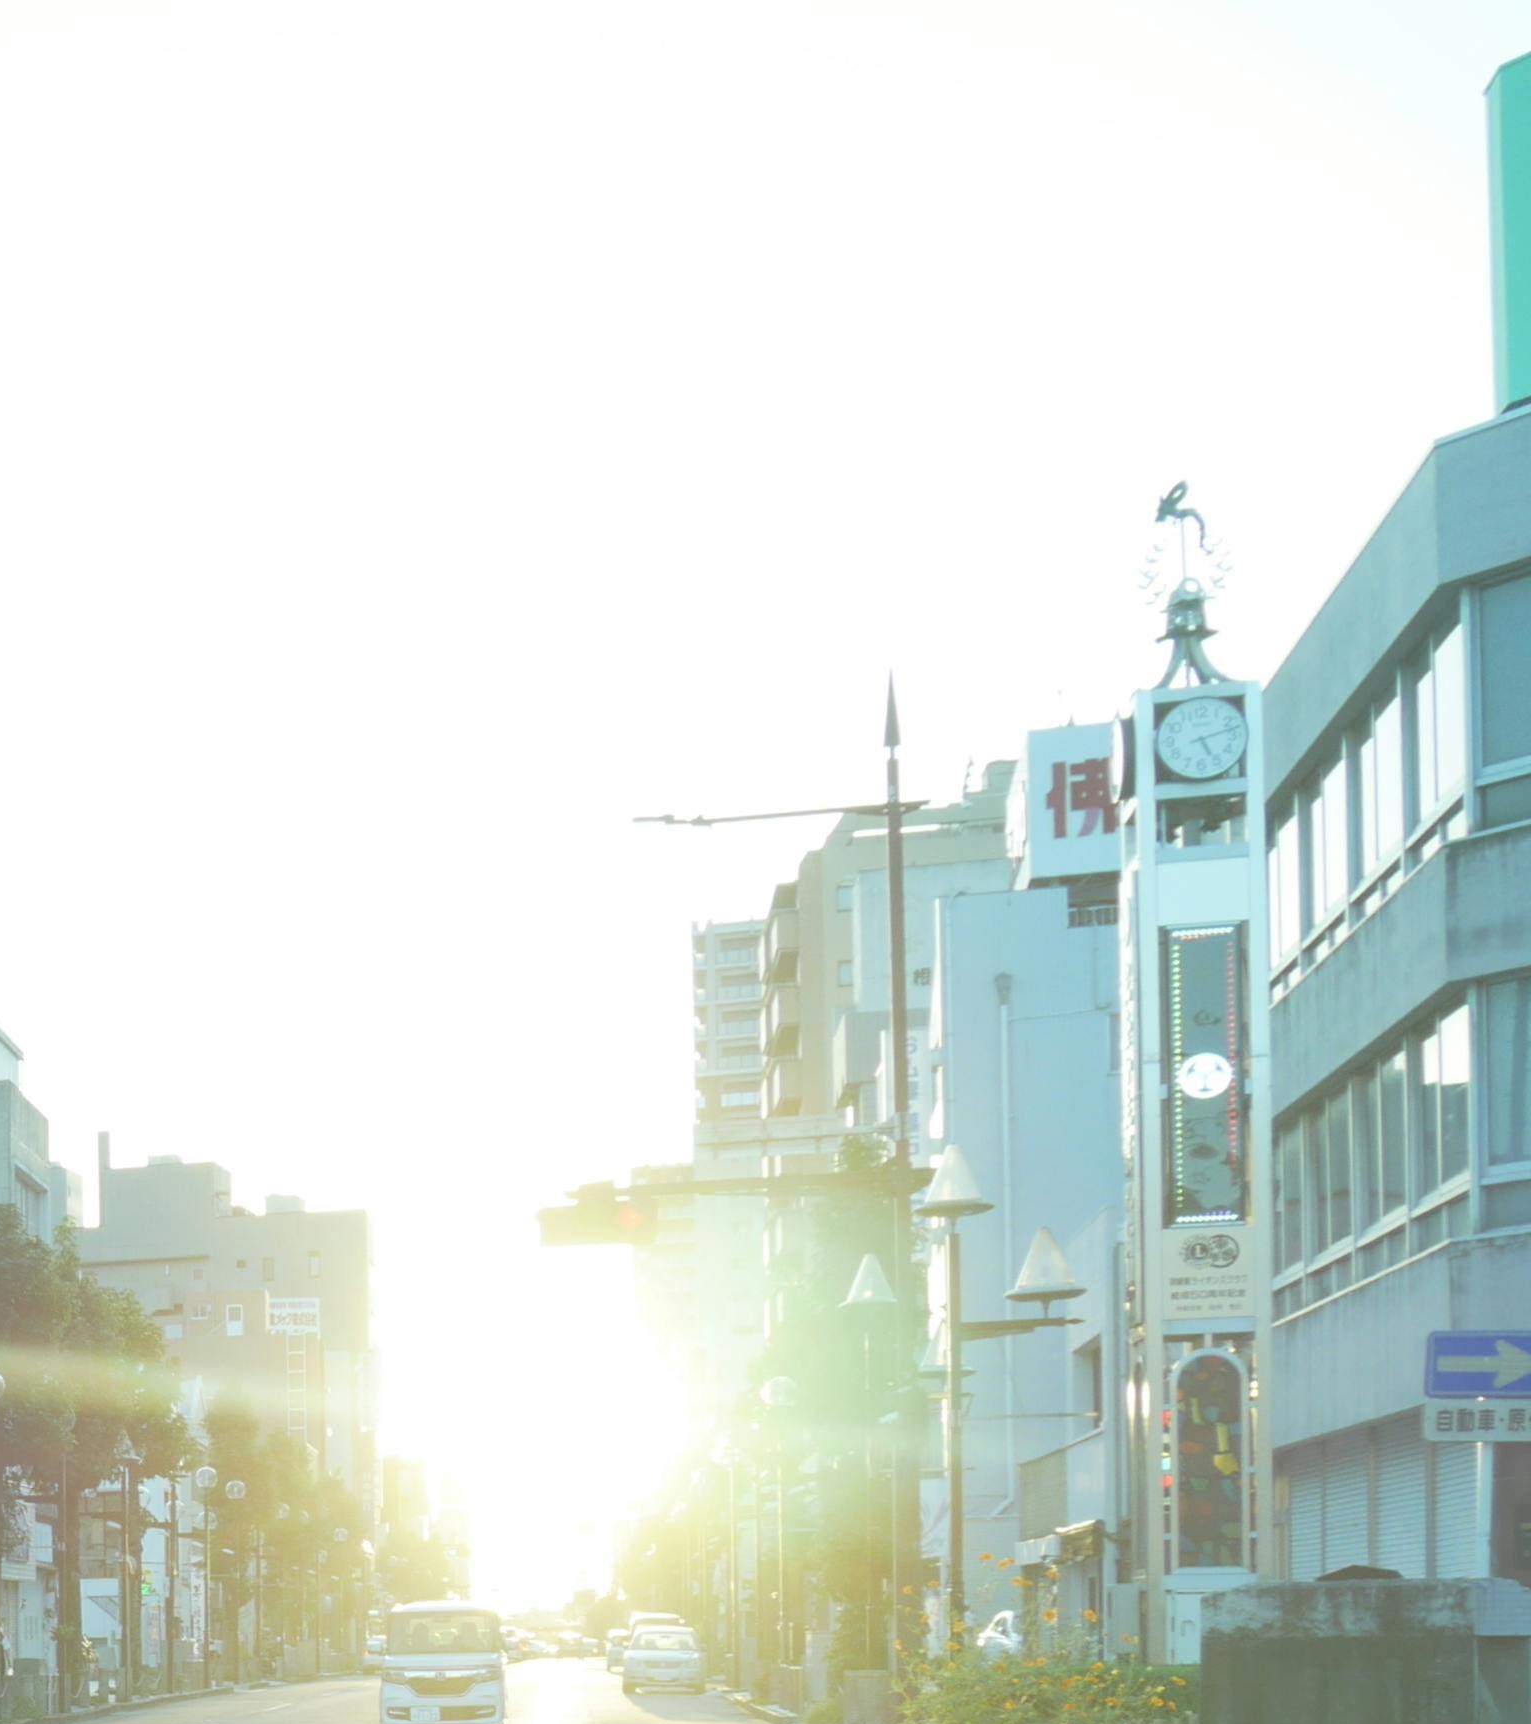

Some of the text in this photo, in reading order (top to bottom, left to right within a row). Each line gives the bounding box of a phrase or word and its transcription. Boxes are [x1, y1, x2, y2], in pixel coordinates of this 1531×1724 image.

[1436, 1408, 1531, 1432] 自動車・原
